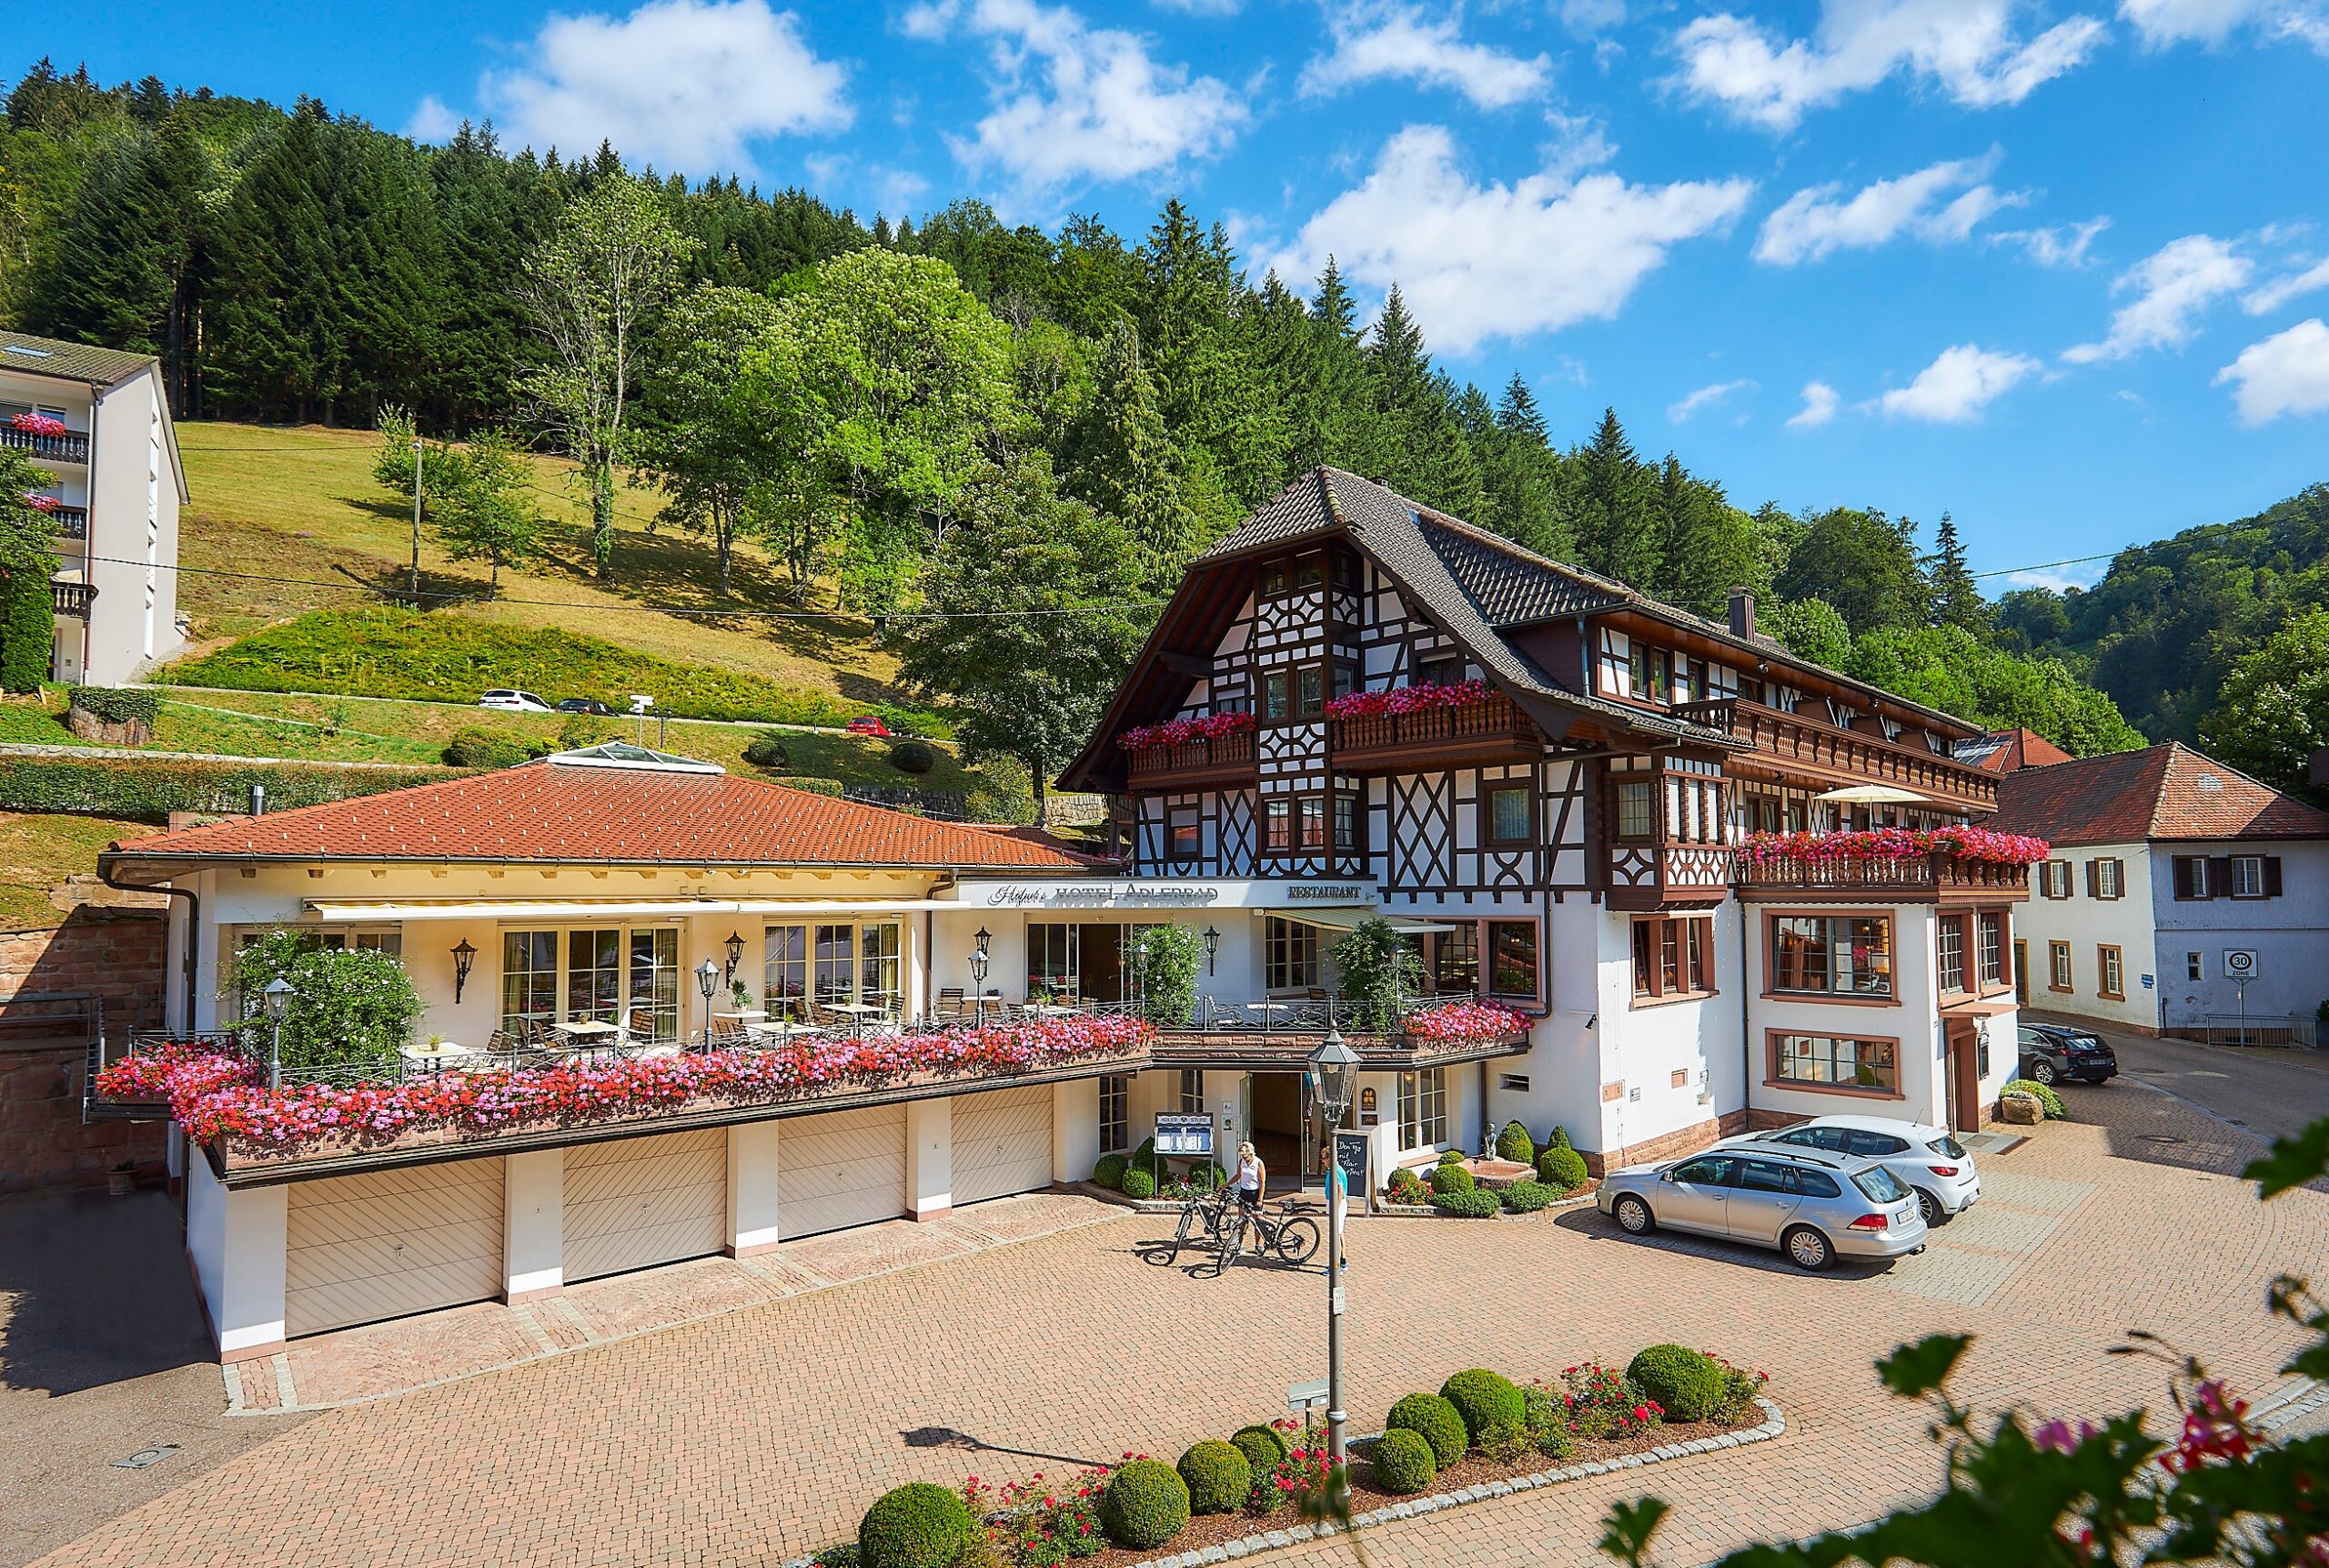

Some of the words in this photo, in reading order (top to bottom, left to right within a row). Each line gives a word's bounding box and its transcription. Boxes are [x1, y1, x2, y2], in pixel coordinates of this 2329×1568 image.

[1055, 881, 1118, 900] HOTEL
[1287, 886, 1361, 899] RESTAURANT
[2233, 957, 2248, 966] 30
